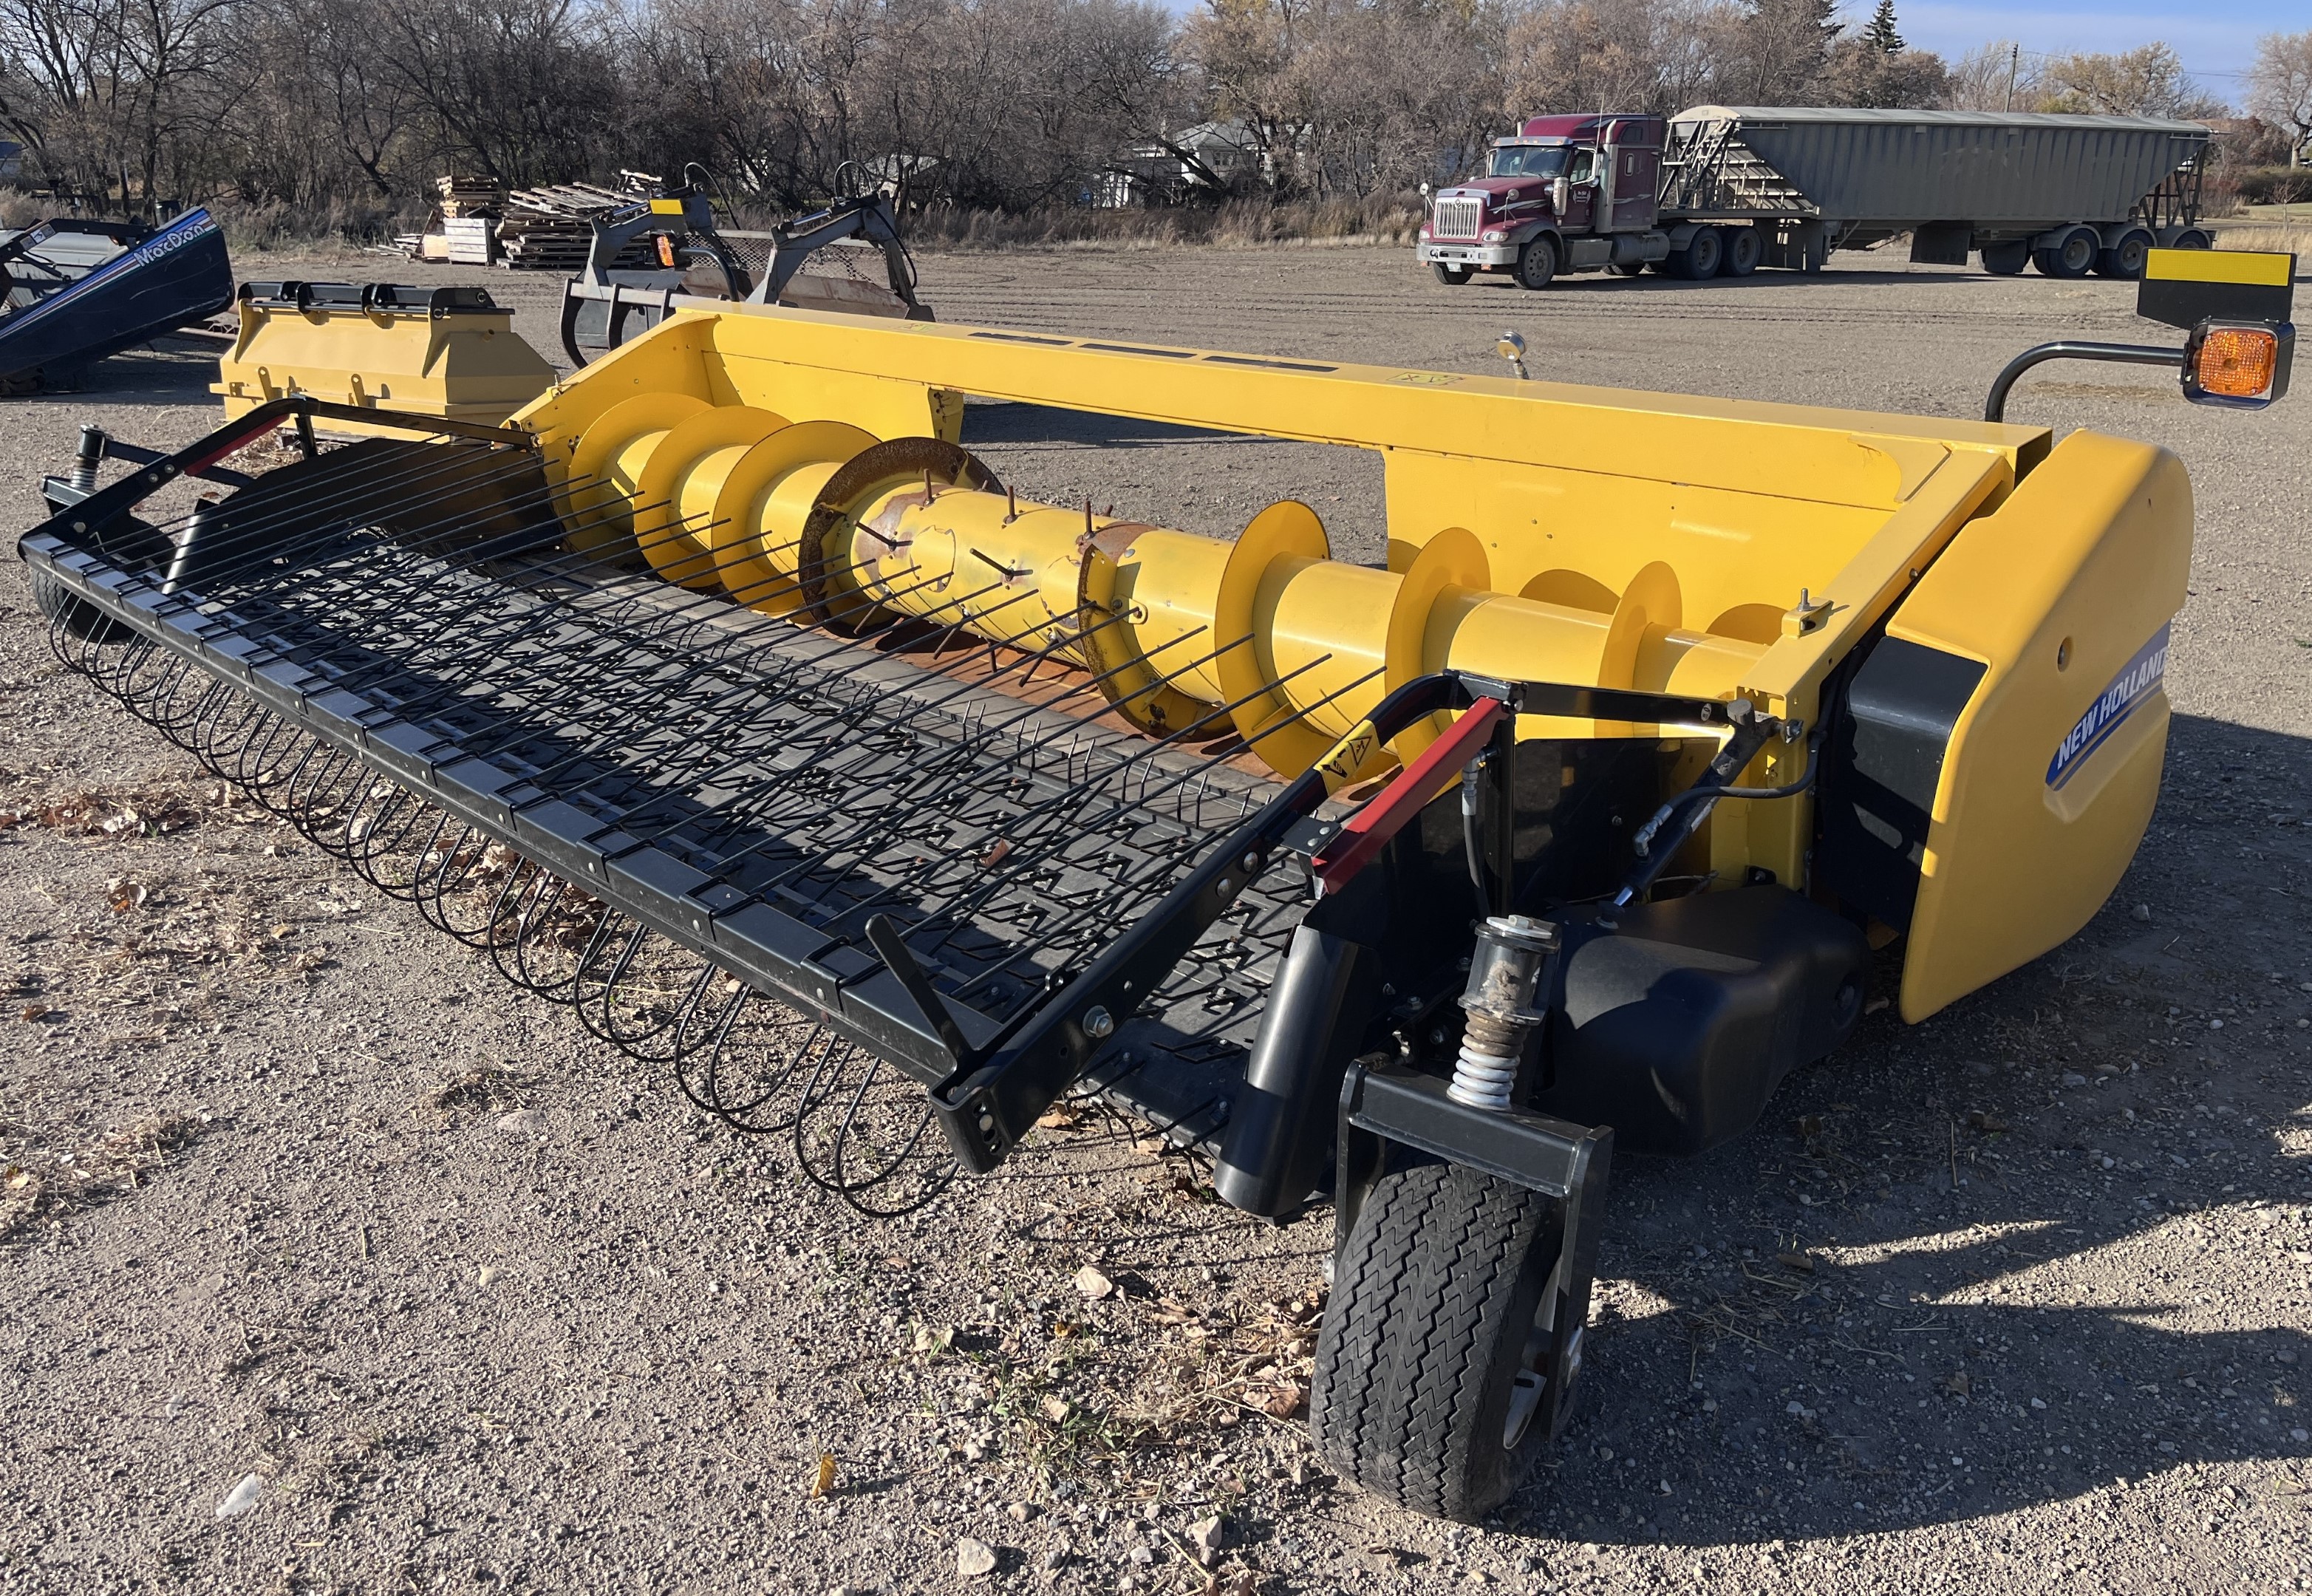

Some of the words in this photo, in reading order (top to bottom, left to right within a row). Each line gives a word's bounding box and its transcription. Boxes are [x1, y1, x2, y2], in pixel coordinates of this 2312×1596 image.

[134, 224, 205, 267] MacDon
[2057, 705, 2098, 770] NEW
[2098, 646, 2168, 726] HOLLAND
